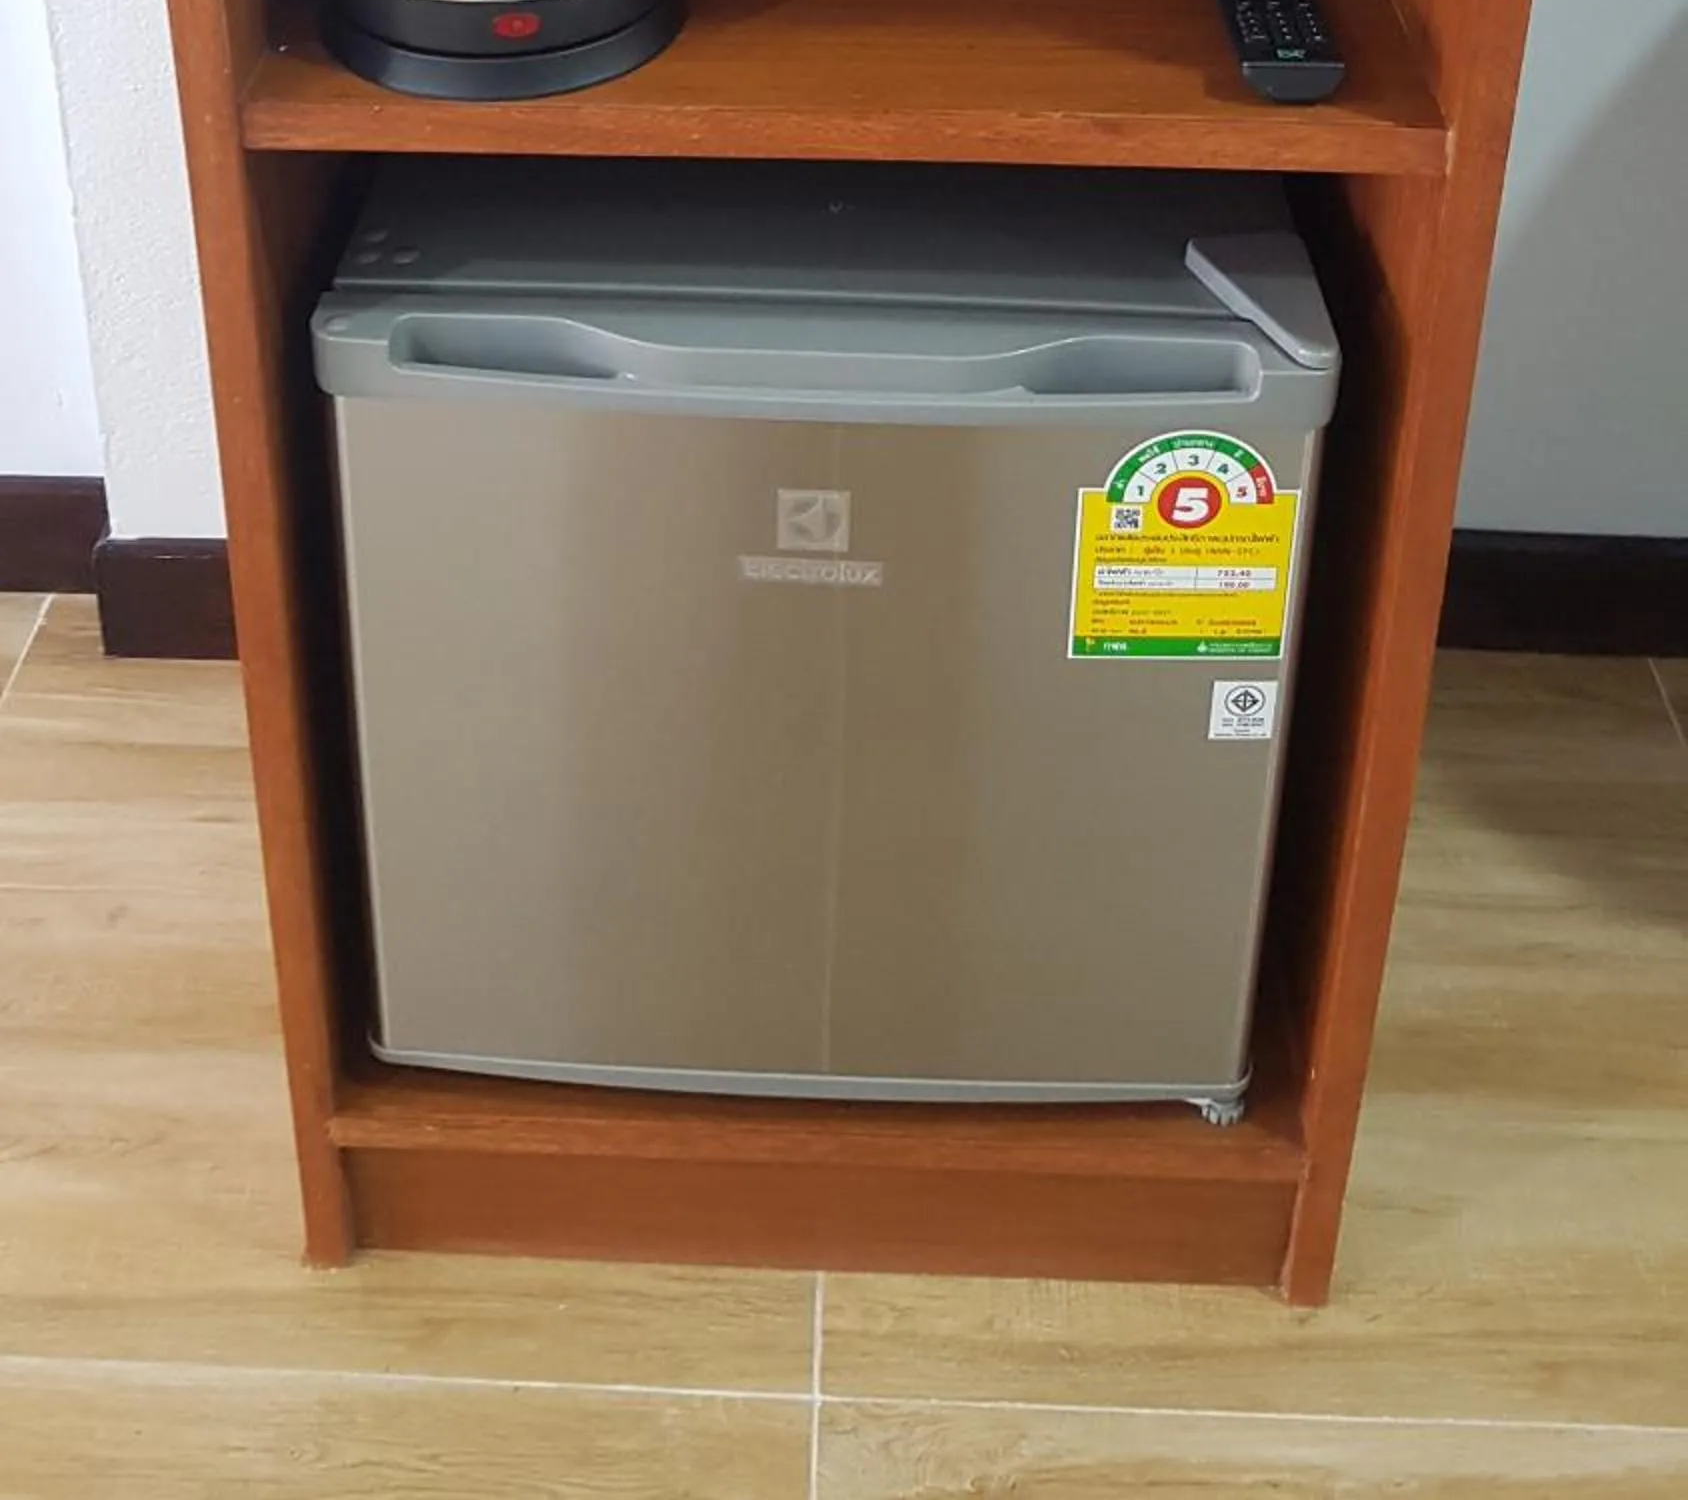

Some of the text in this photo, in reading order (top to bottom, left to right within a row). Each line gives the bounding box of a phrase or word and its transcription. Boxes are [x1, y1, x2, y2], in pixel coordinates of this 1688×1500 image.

[1187, 453, 1200, 467] 3
[1154, 462, 1167, 475] 2
[1216, 463, 1229, 475] 4
[1136, 485, 1145, 497] 1
[1236, 485, 1248, 498] 5
[1171, 486, 1210, 522] 5
